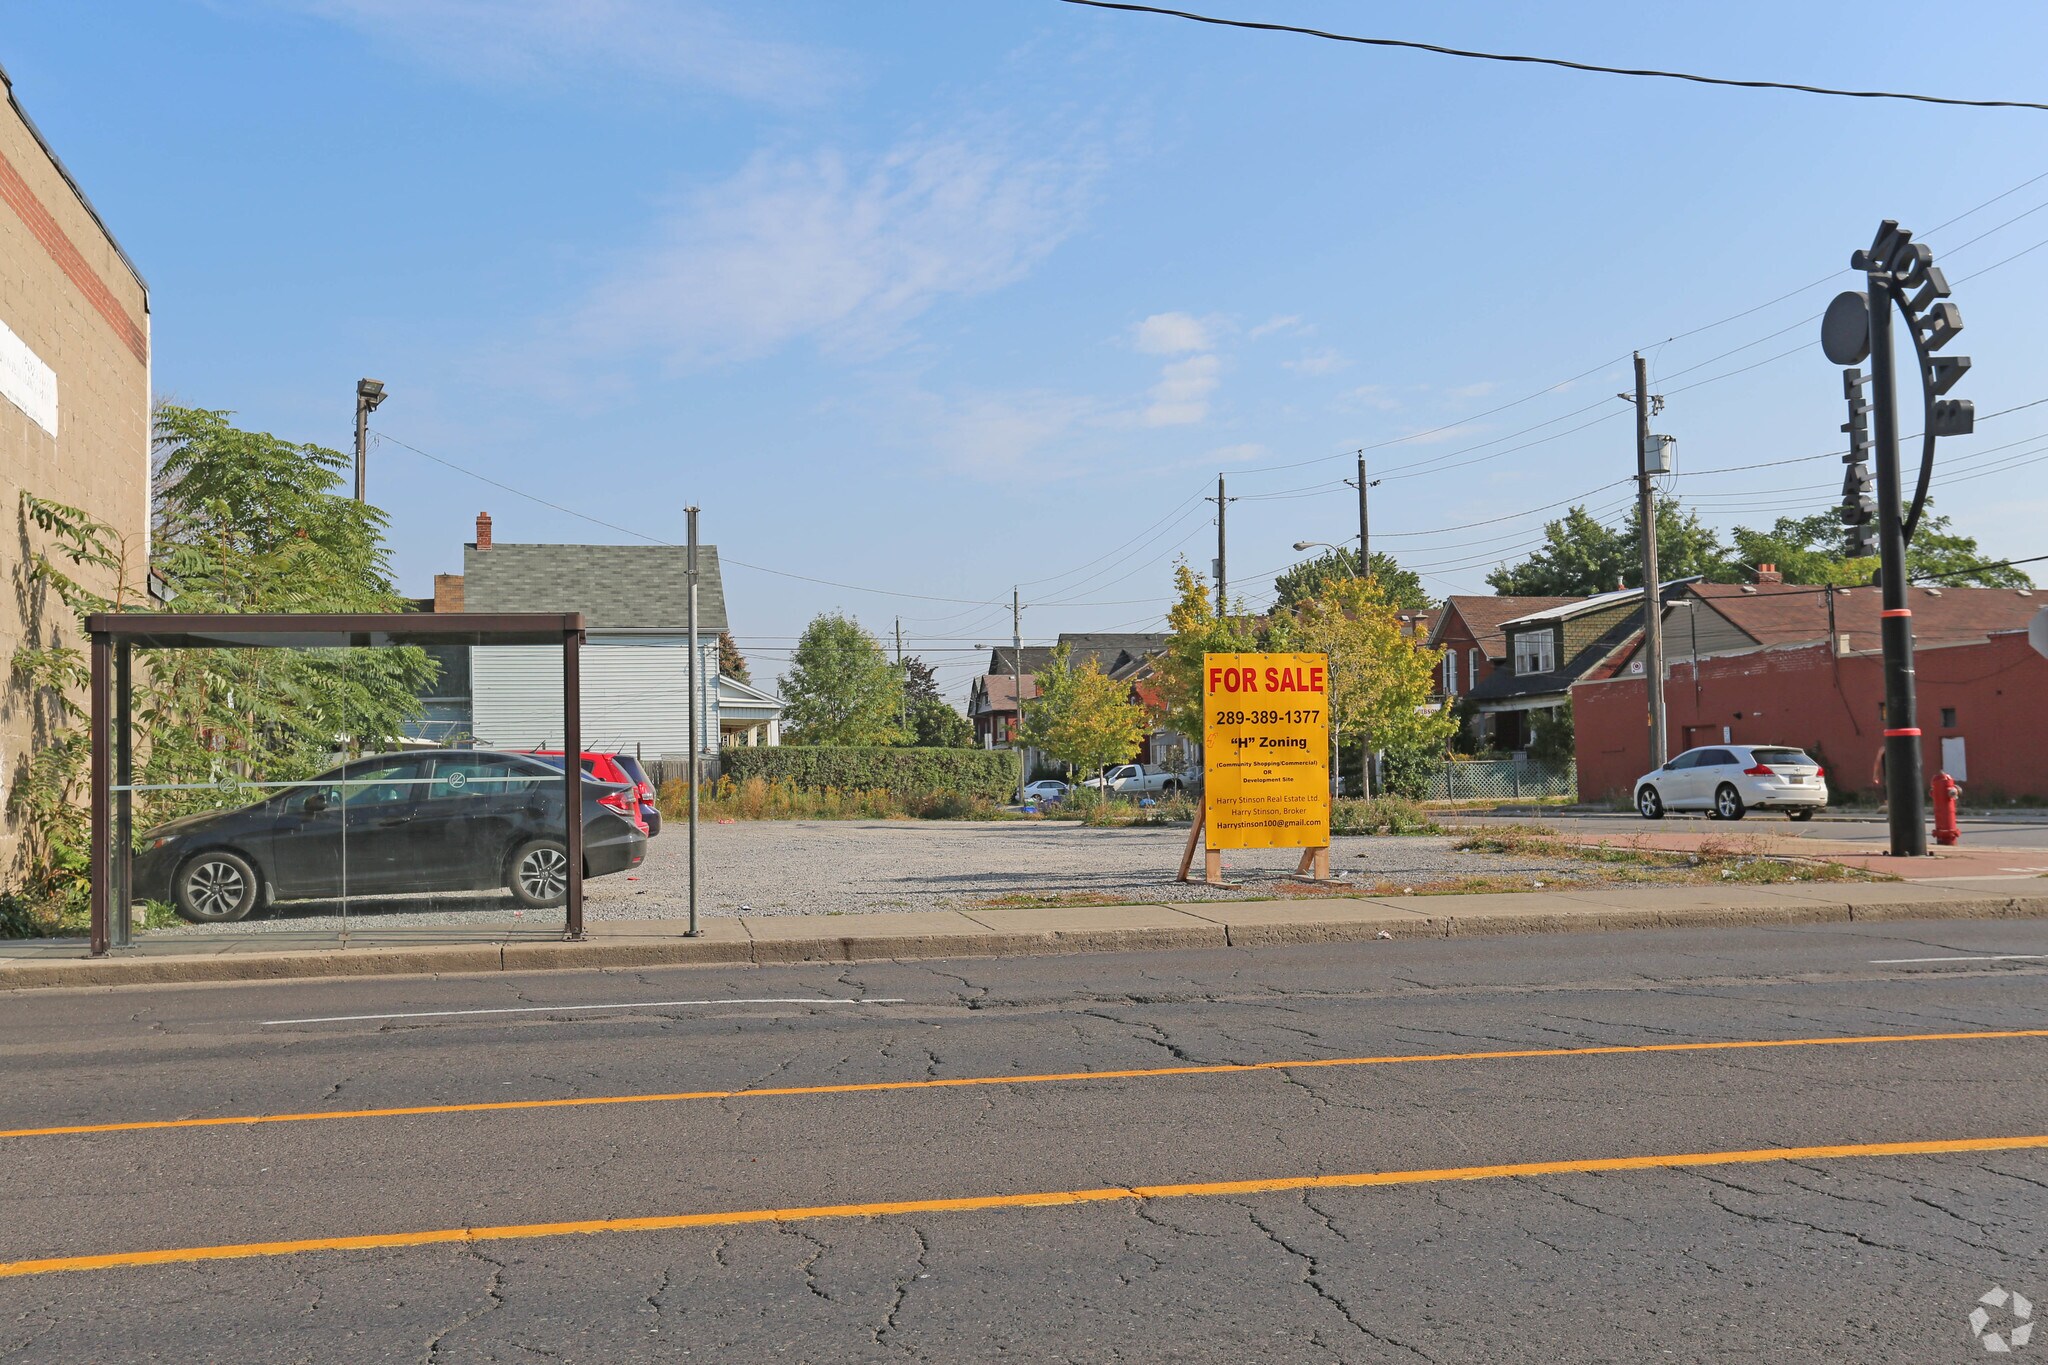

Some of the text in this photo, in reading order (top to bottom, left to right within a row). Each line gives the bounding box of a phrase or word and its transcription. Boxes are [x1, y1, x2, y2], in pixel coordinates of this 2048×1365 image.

[1209, 667, 1324, 693] FOR SALE
[1216, 710, 1320, 725] 289-389-1377
[1231, 736, 1307, 750] “H” Zoning
[1216, 761, 1252, 769] (Community
[1216, 795, 1320, 806] Harry Stinson Real Estate Ltd.
[1231, 807, 1307, 817] Harry Stinson, Broker
[1217, 819, 1321, 830] Harrystinson100@gmail.com
